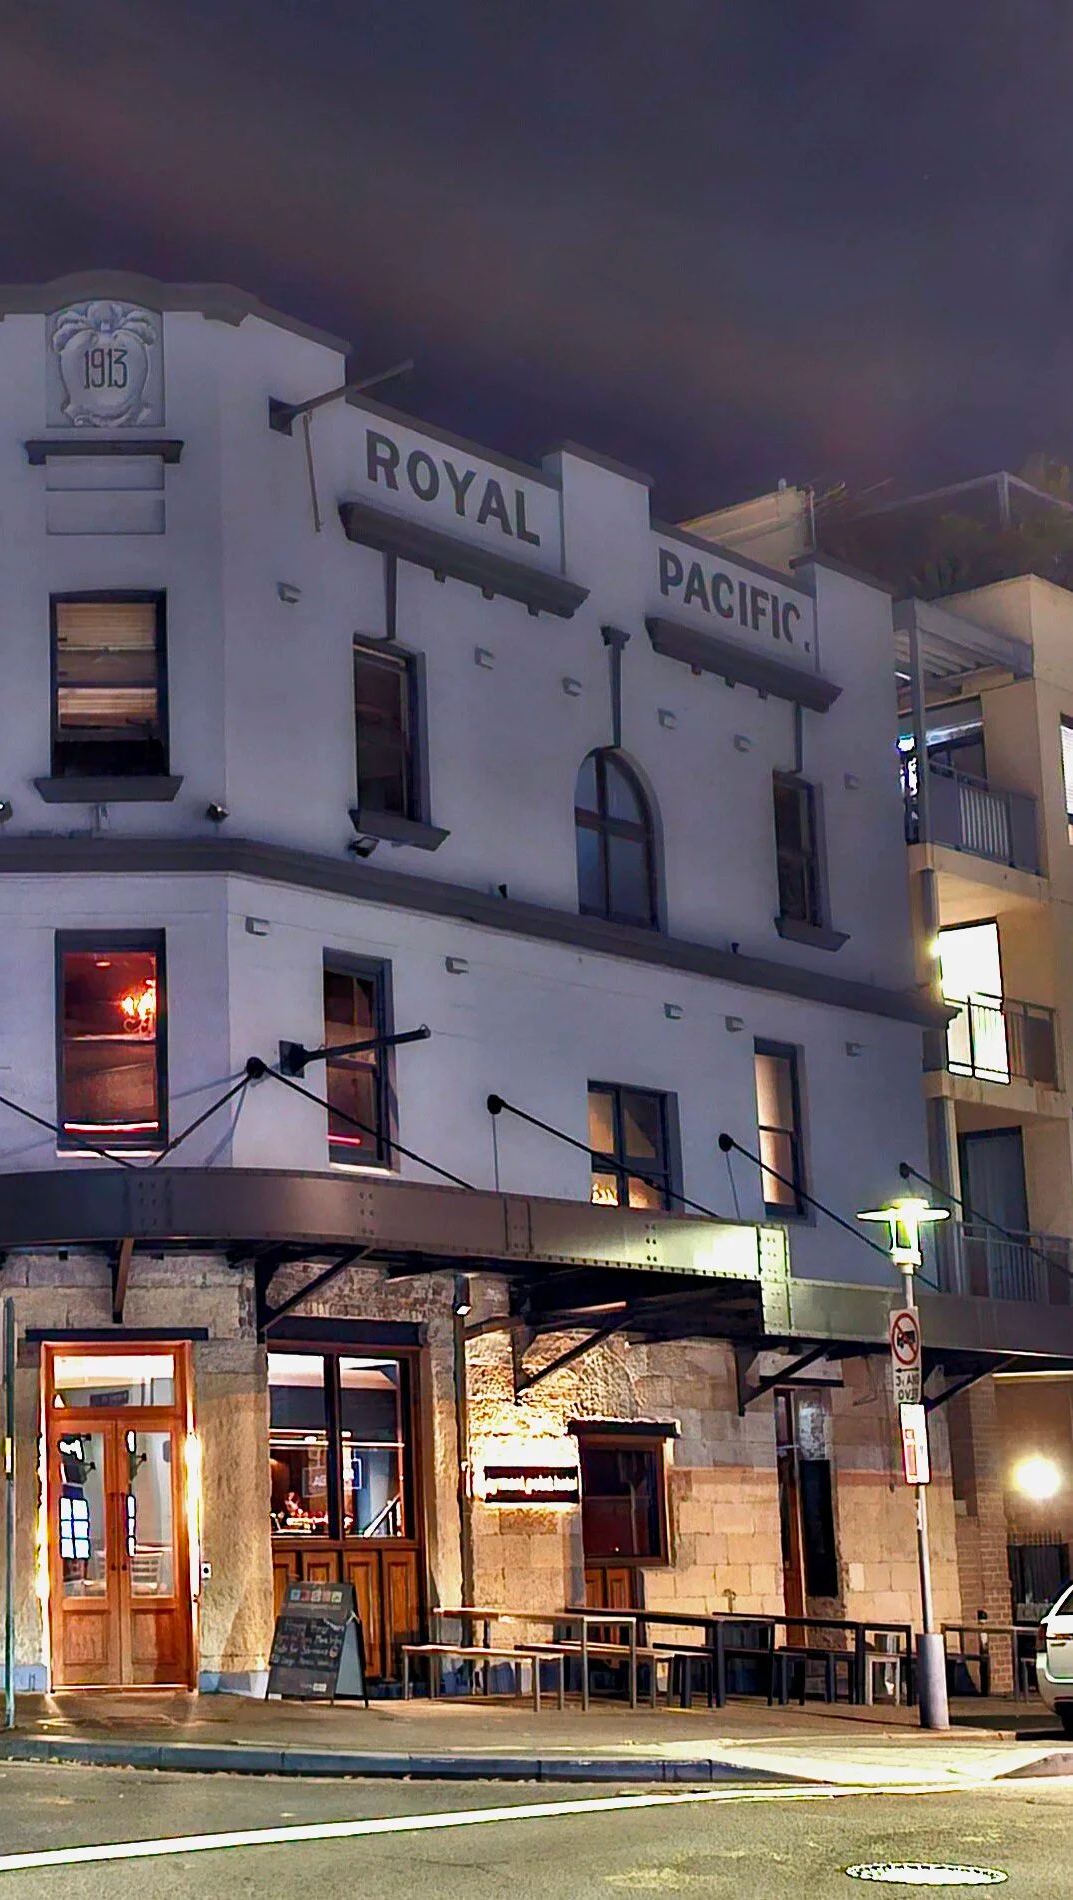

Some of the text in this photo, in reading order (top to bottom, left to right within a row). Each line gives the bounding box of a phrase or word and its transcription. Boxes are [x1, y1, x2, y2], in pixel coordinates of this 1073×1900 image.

[84, 348, 128, 389] 1913
[366, 428, 541, 547] ROYAL
[659, 547, 810, 653] PACIFIC.
